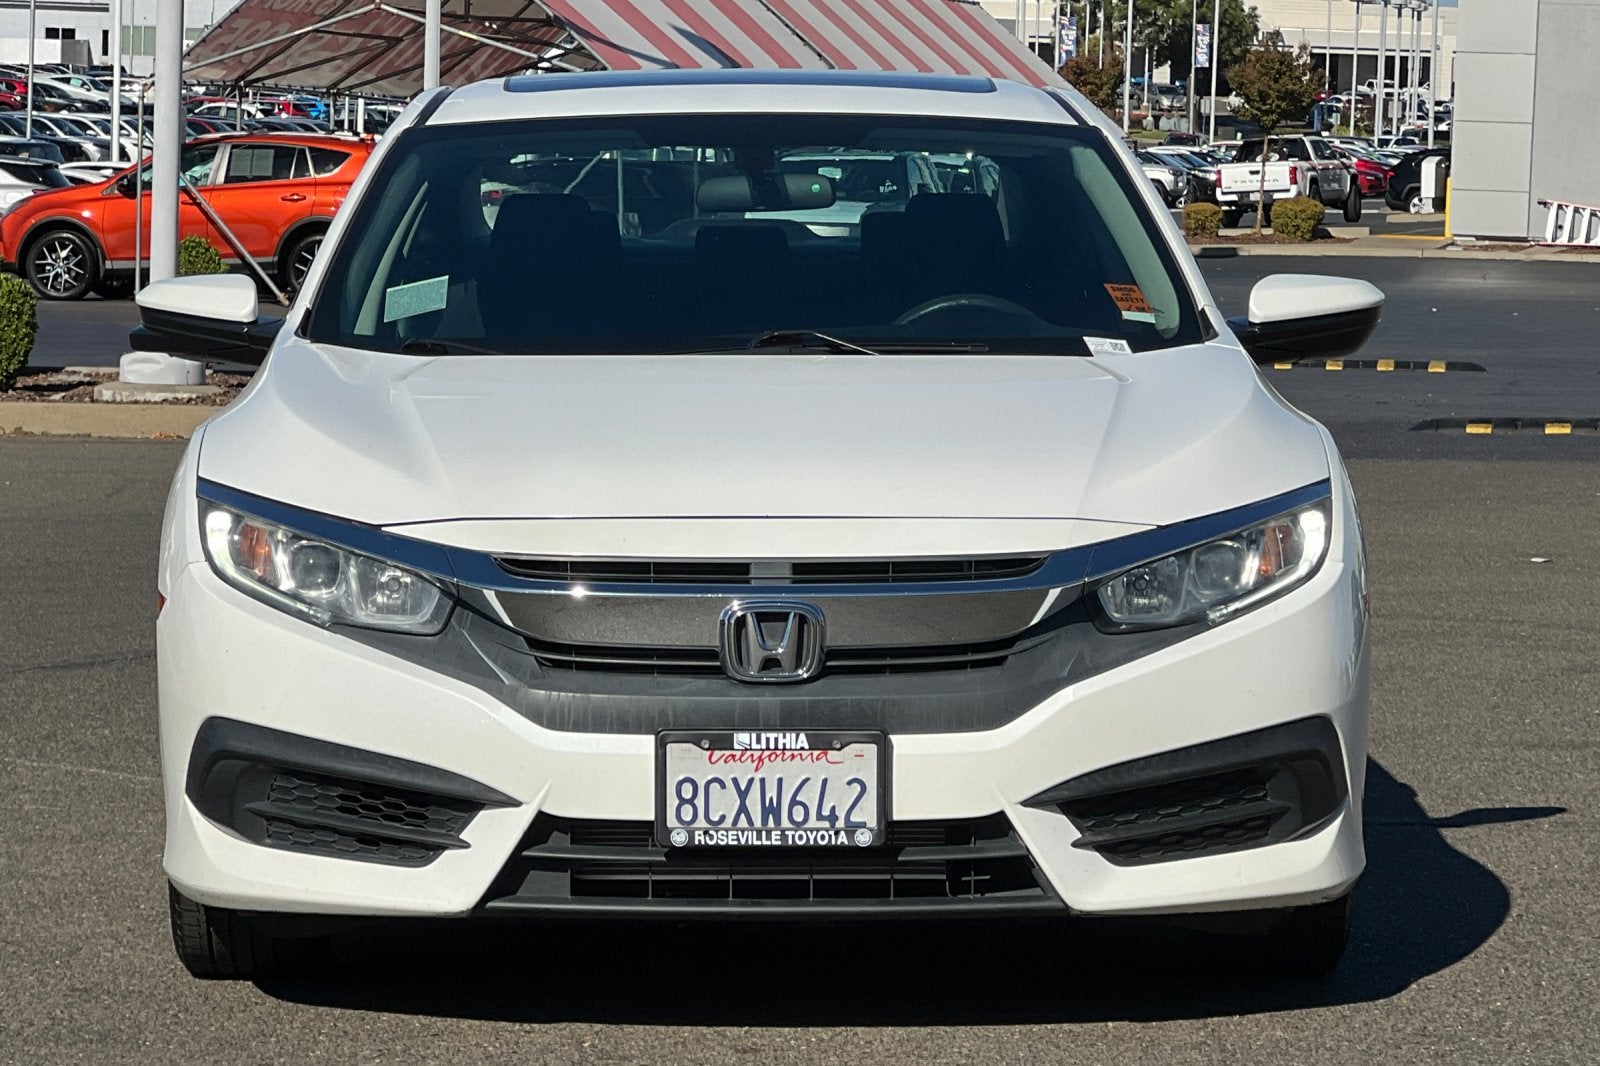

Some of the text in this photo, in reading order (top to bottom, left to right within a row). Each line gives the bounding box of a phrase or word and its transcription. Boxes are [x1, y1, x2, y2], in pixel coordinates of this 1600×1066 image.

[750, 732, 810, 750] LITHIA
[708, 749, 844, 772] California
[675, 776, 867, 828] 8CXW642
[694, 830, 849, 845] ROSEVILLE TOYOTA
